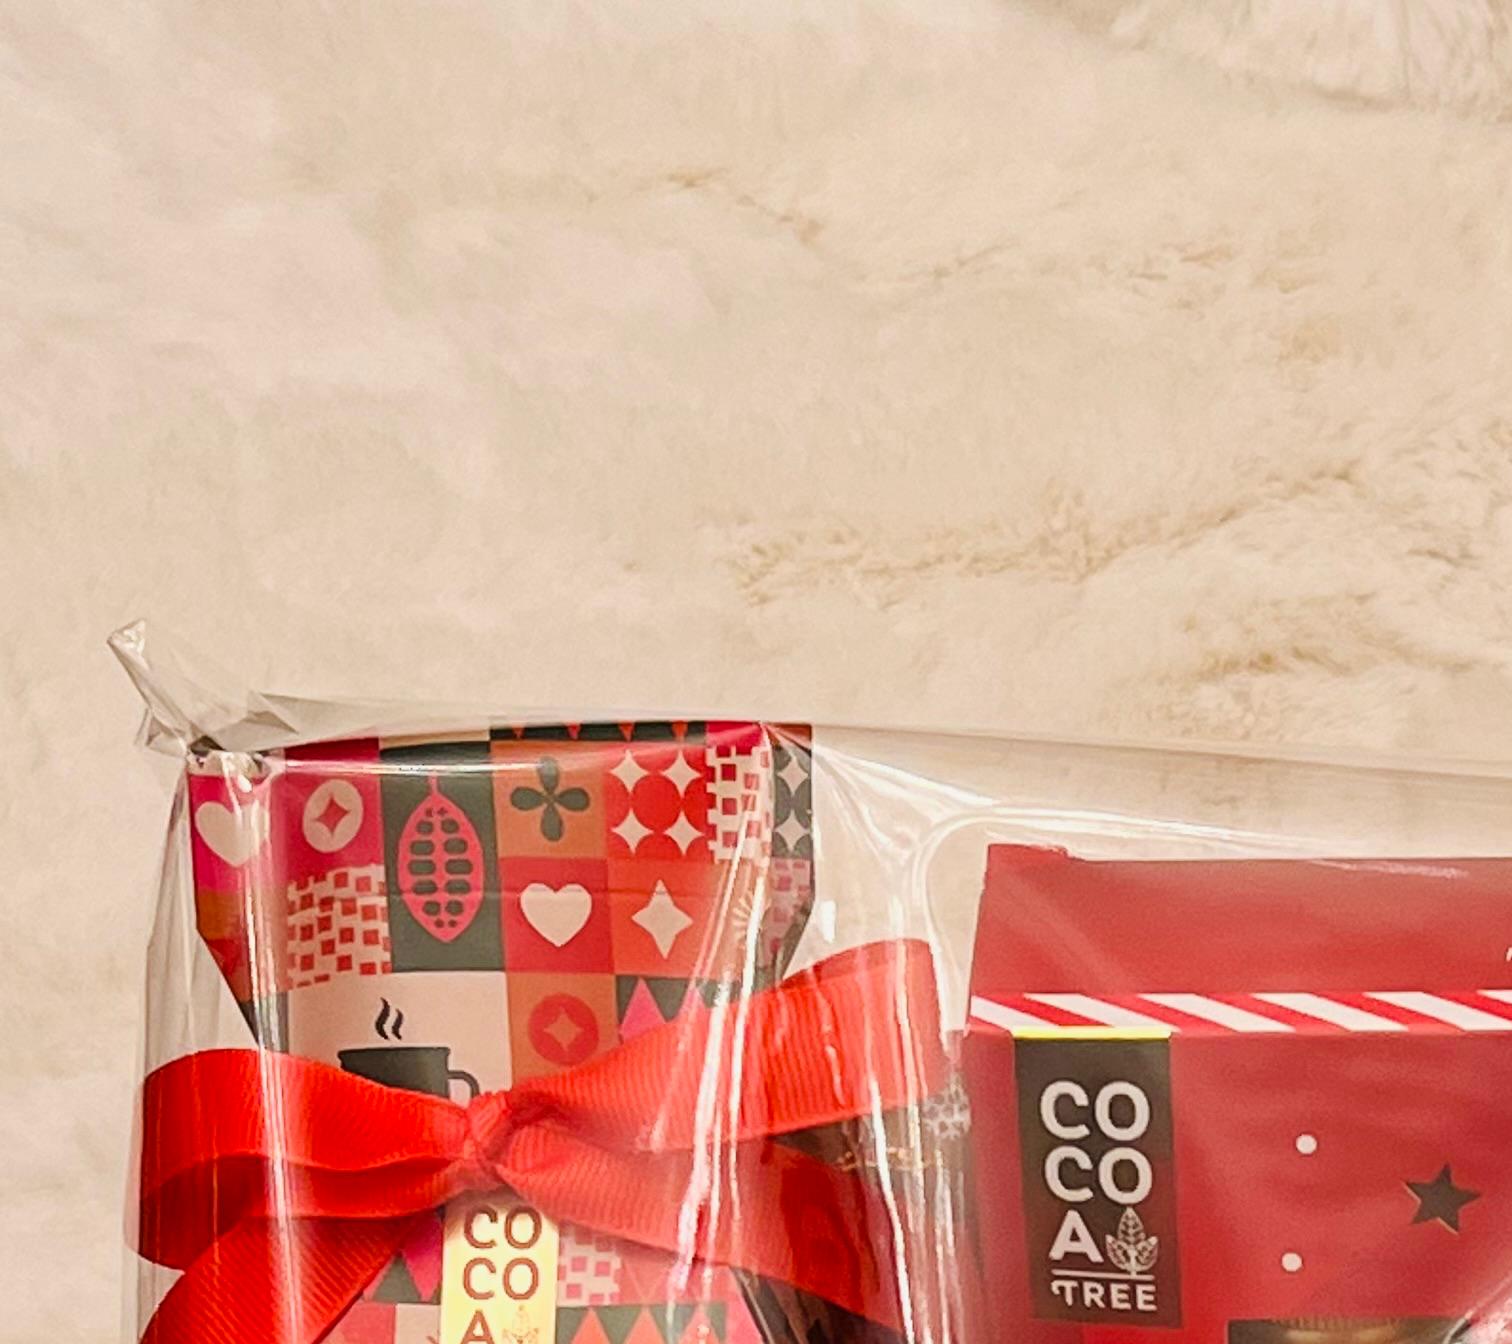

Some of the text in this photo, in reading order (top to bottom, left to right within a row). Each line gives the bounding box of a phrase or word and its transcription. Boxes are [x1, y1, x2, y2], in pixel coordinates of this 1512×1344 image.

[1040, 1080, 1150, 1142] CO
[1045, 1145, 1153, 1205] CO
[463, 1203, 542, 1250] CO
[1049, 1209, 1104, 1263] A
[462, 1257, 540, 1301] CO
[1051, 1279, 1158, 1312] TREE
